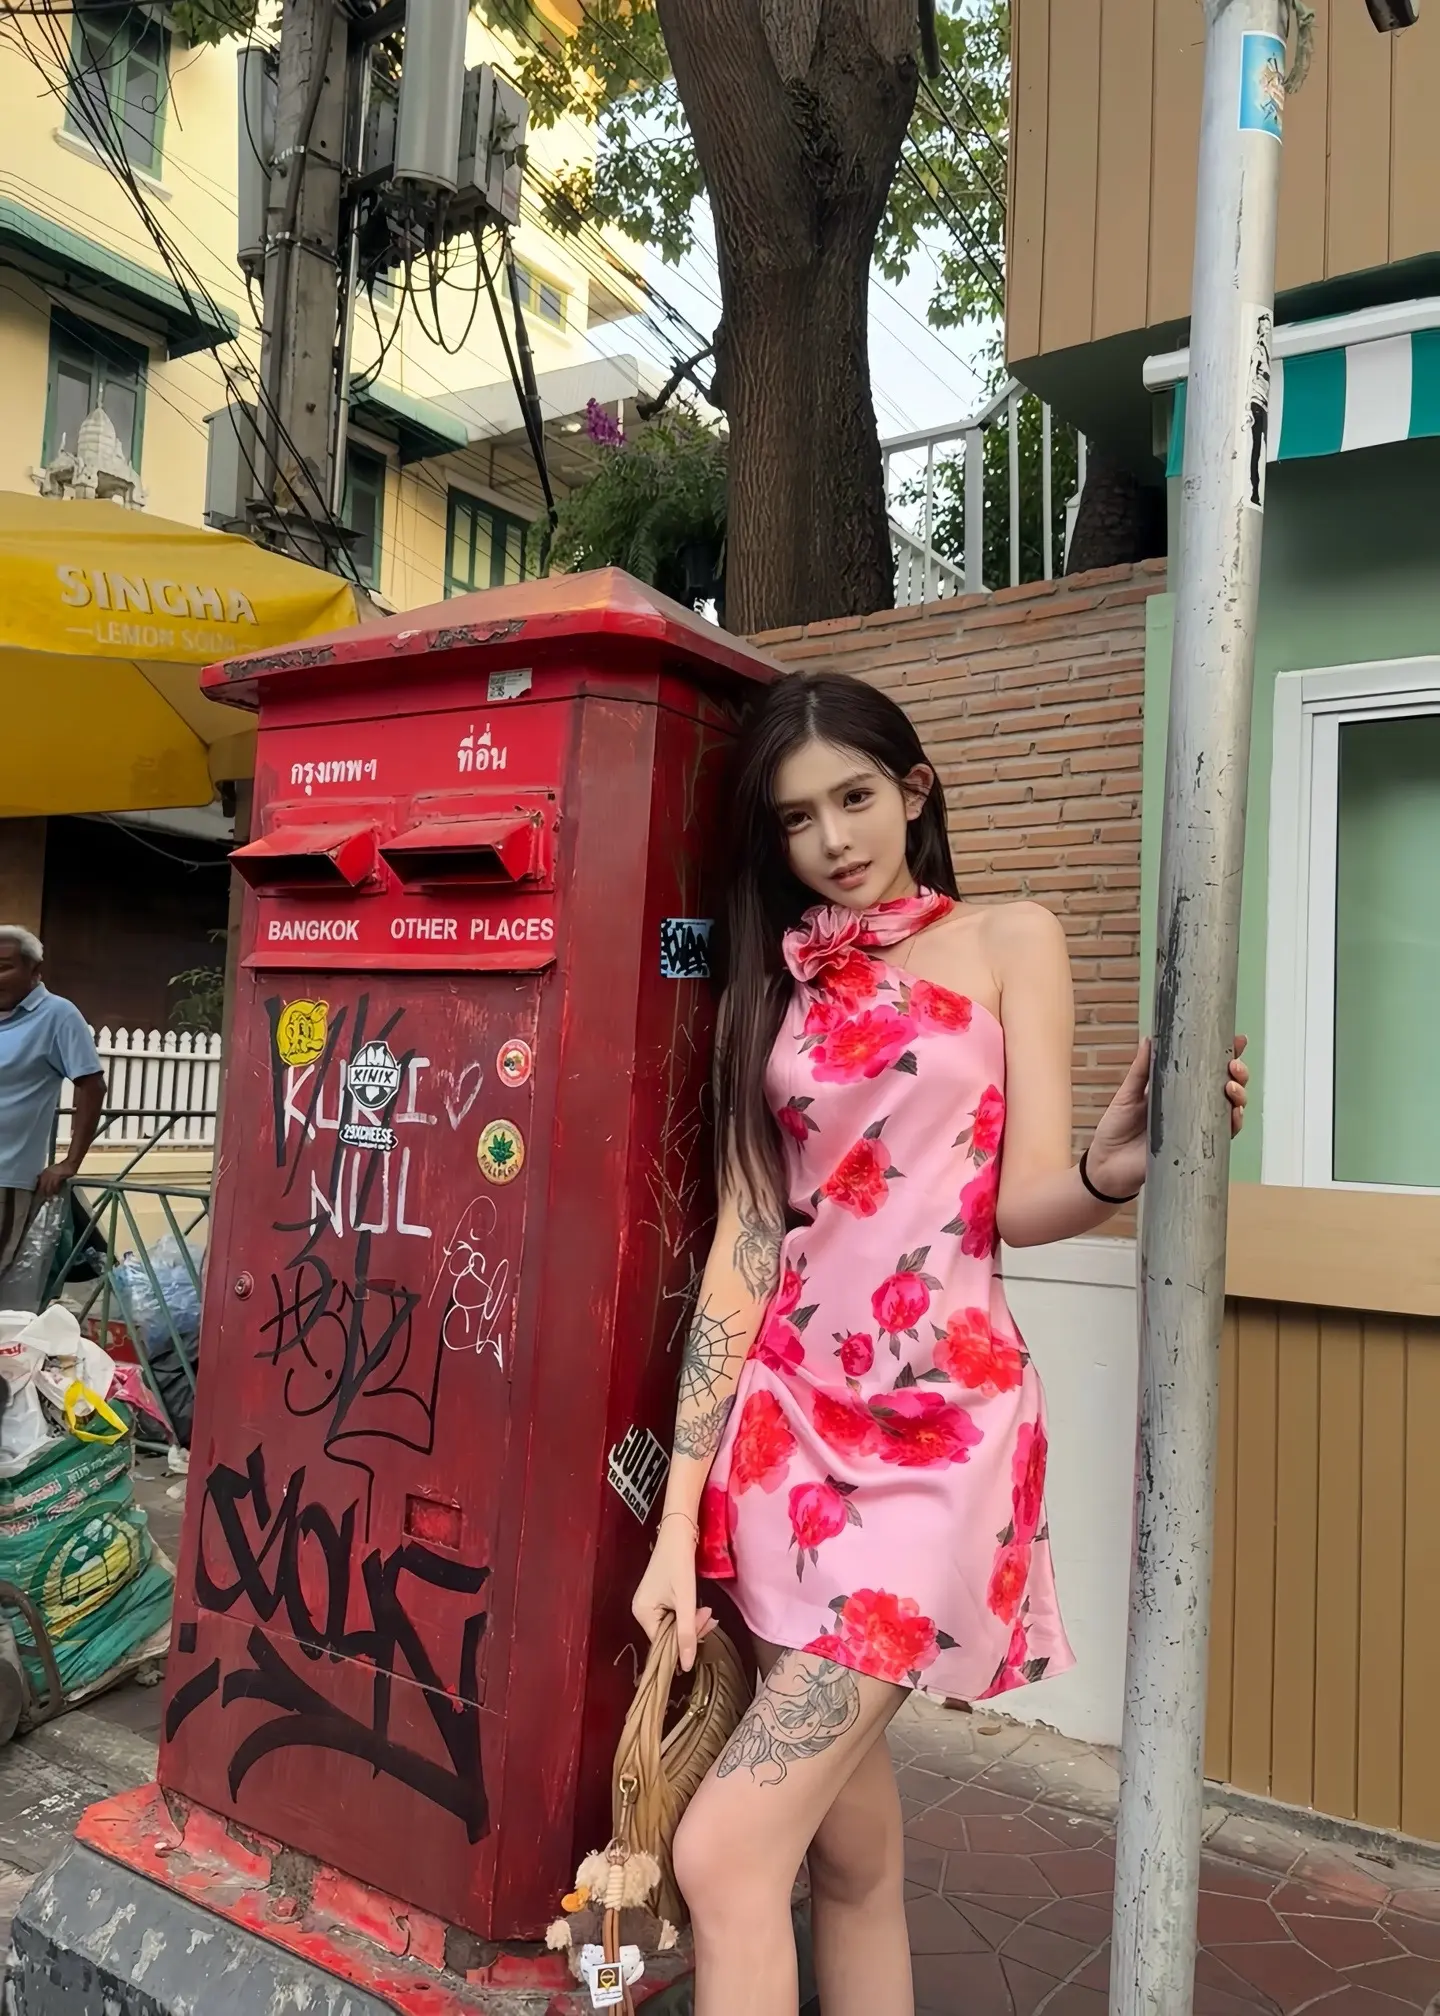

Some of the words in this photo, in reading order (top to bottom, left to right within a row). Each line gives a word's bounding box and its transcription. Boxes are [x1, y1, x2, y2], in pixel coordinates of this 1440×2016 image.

[57, 564, 260, 626] SINGHA
[95, 621, 176, 646] LEMON
[181, 628, 236, 653] SODA
[457, 723, 507, 773] ที่อื่น
[290, 758, 378, 796] กรุงเทพฯ
[268, 919, 360, 941] BANGKOK
[390, 917, 458, 940] OTHER
[470, 917, 554, 941] PLACES
